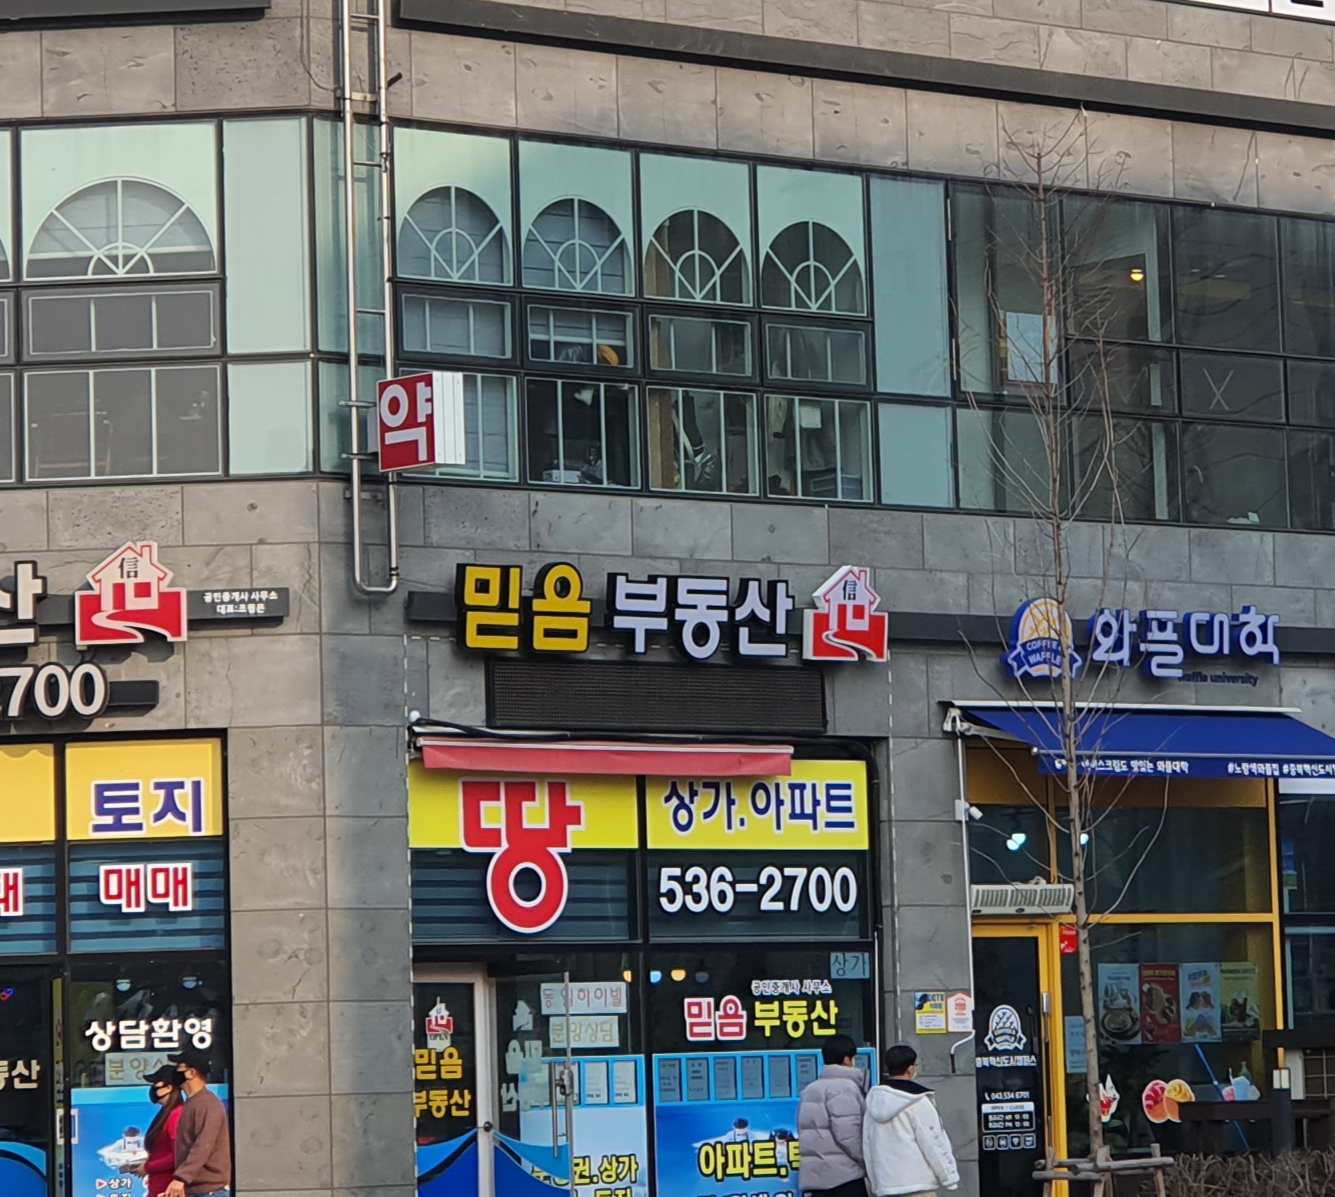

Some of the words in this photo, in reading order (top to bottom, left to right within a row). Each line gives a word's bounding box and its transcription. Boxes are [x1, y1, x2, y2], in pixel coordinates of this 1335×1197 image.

[380, 383, 433, 462] 약
[118, 556, 139, 579] 信
[460, 562, 592, 653] 믿음
[612, 573, 795, 660] 부동산
[1091, 605, 1281, 678] 와플대학
[90, 778, 204, 834] 토지
[460, 778, 584, 934] 땅
[99, 862, 193, 912] 매매
[659, 866, 858, 913] 536-2700
[84, 1017, 213, 1052] 상담환영
[684, 995, 748, 1042] 믿음
[753, 999, 839, 1039] 부동산
[415, 1046, 463, 1081] 믿음
